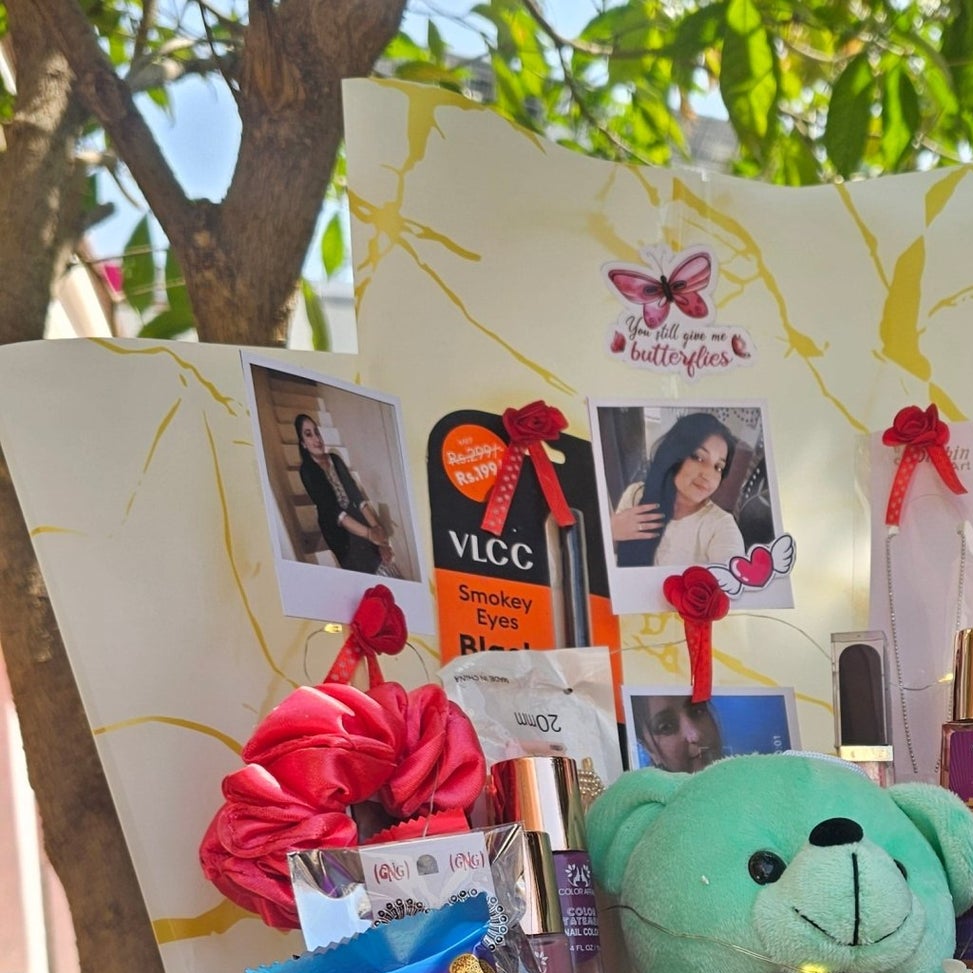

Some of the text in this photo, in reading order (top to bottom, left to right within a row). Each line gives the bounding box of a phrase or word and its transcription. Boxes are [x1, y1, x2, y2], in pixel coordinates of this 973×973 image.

[625, 315, 728, 349] You still give me
[630, 341, 733, 378] butterflies
[448, 529, 535, 571] VLCC
[458, 584, 533, 615] Smokey
[476, 608, 519, 630] Eyes
